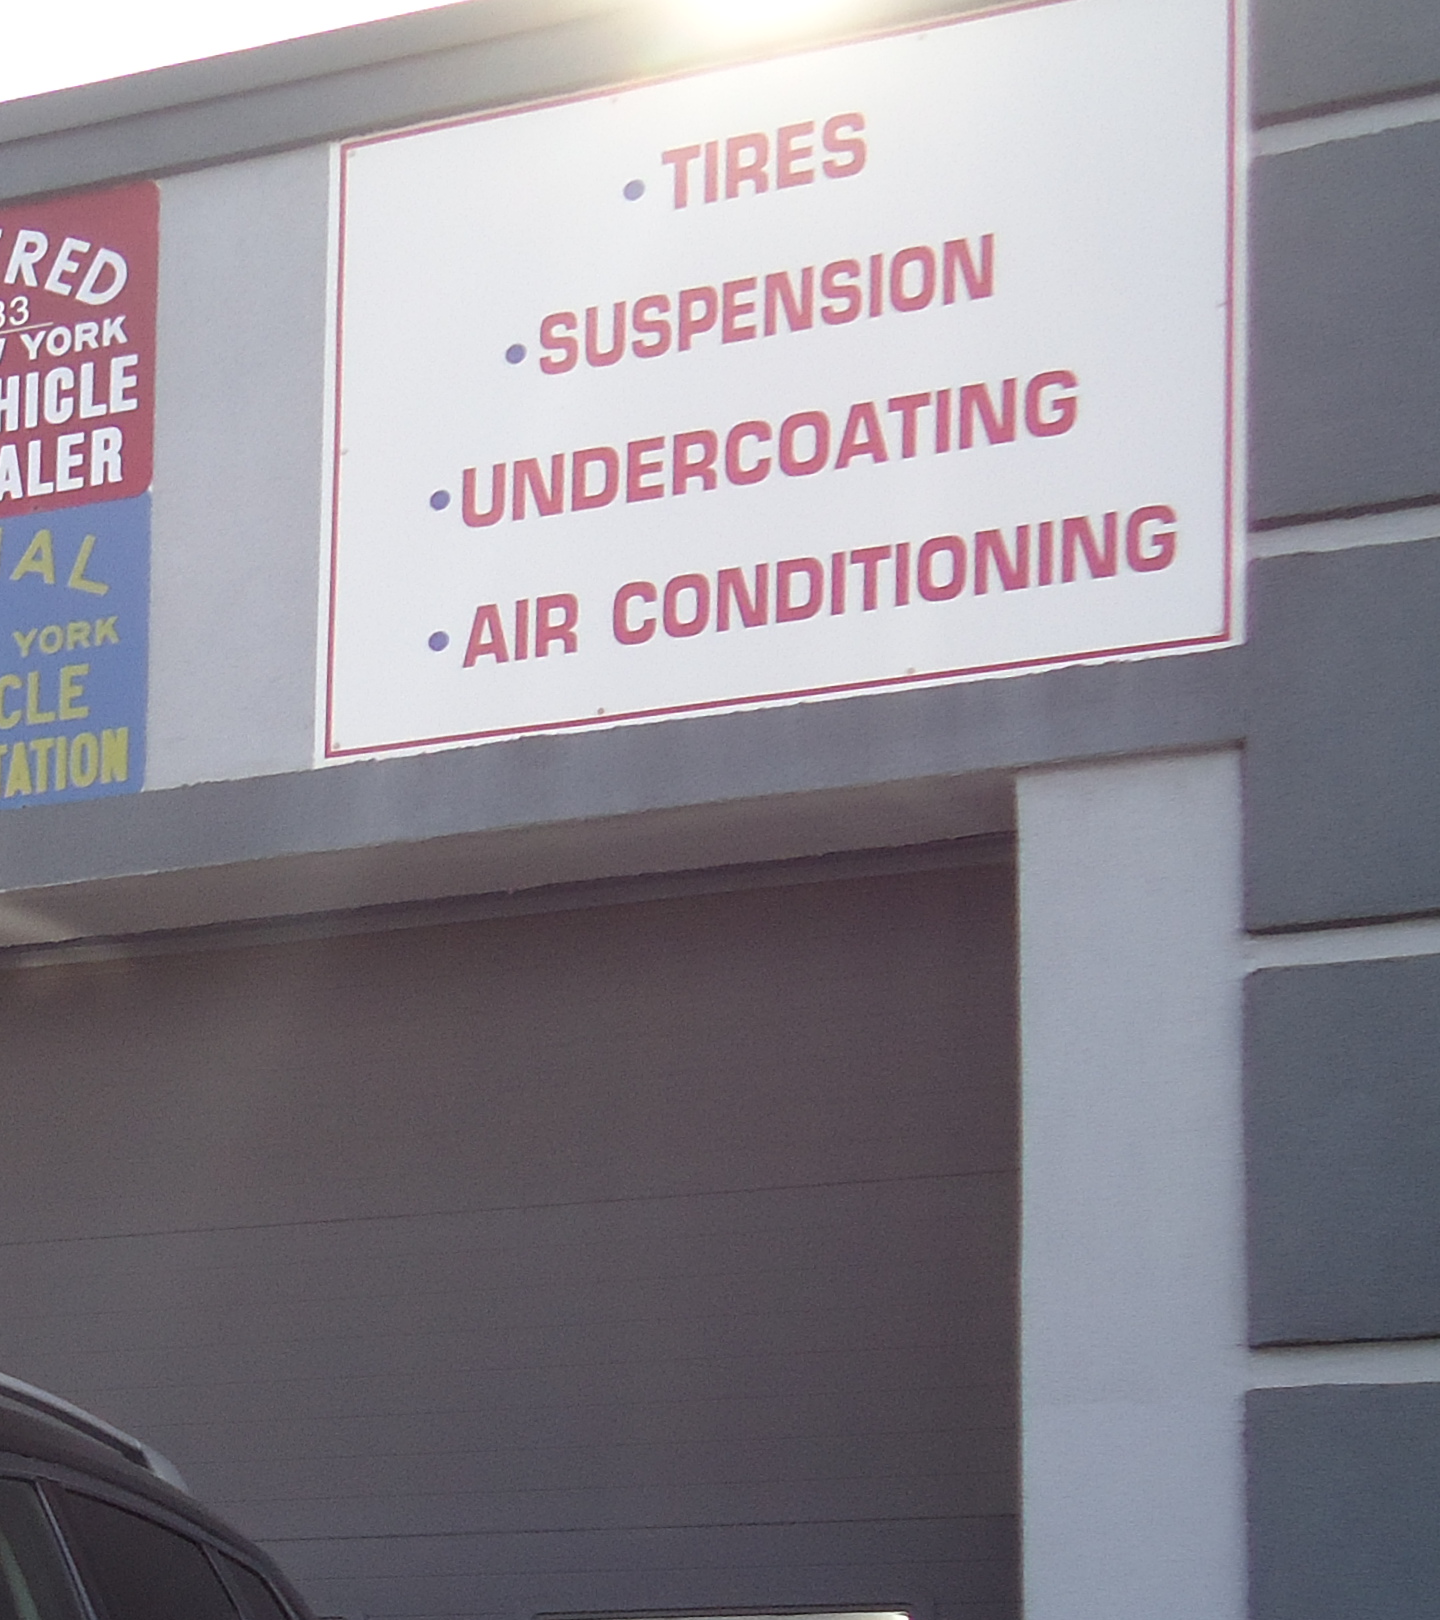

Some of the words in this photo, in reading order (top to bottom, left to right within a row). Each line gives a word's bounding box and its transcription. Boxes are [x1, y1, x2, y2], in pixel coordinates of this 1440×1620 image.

[661, 112, 868, 209] TIRES
[20, 315, 127, 361] YORK
[538, 233, 996, 376] SUSPENSION
[461, 369, 1080, 529] UNDERCOATING
[12, 616, 119, 658] YORK
[462, 592, 579, 669] AIR
[611, 503, 1178, 646] CONDITIONING
